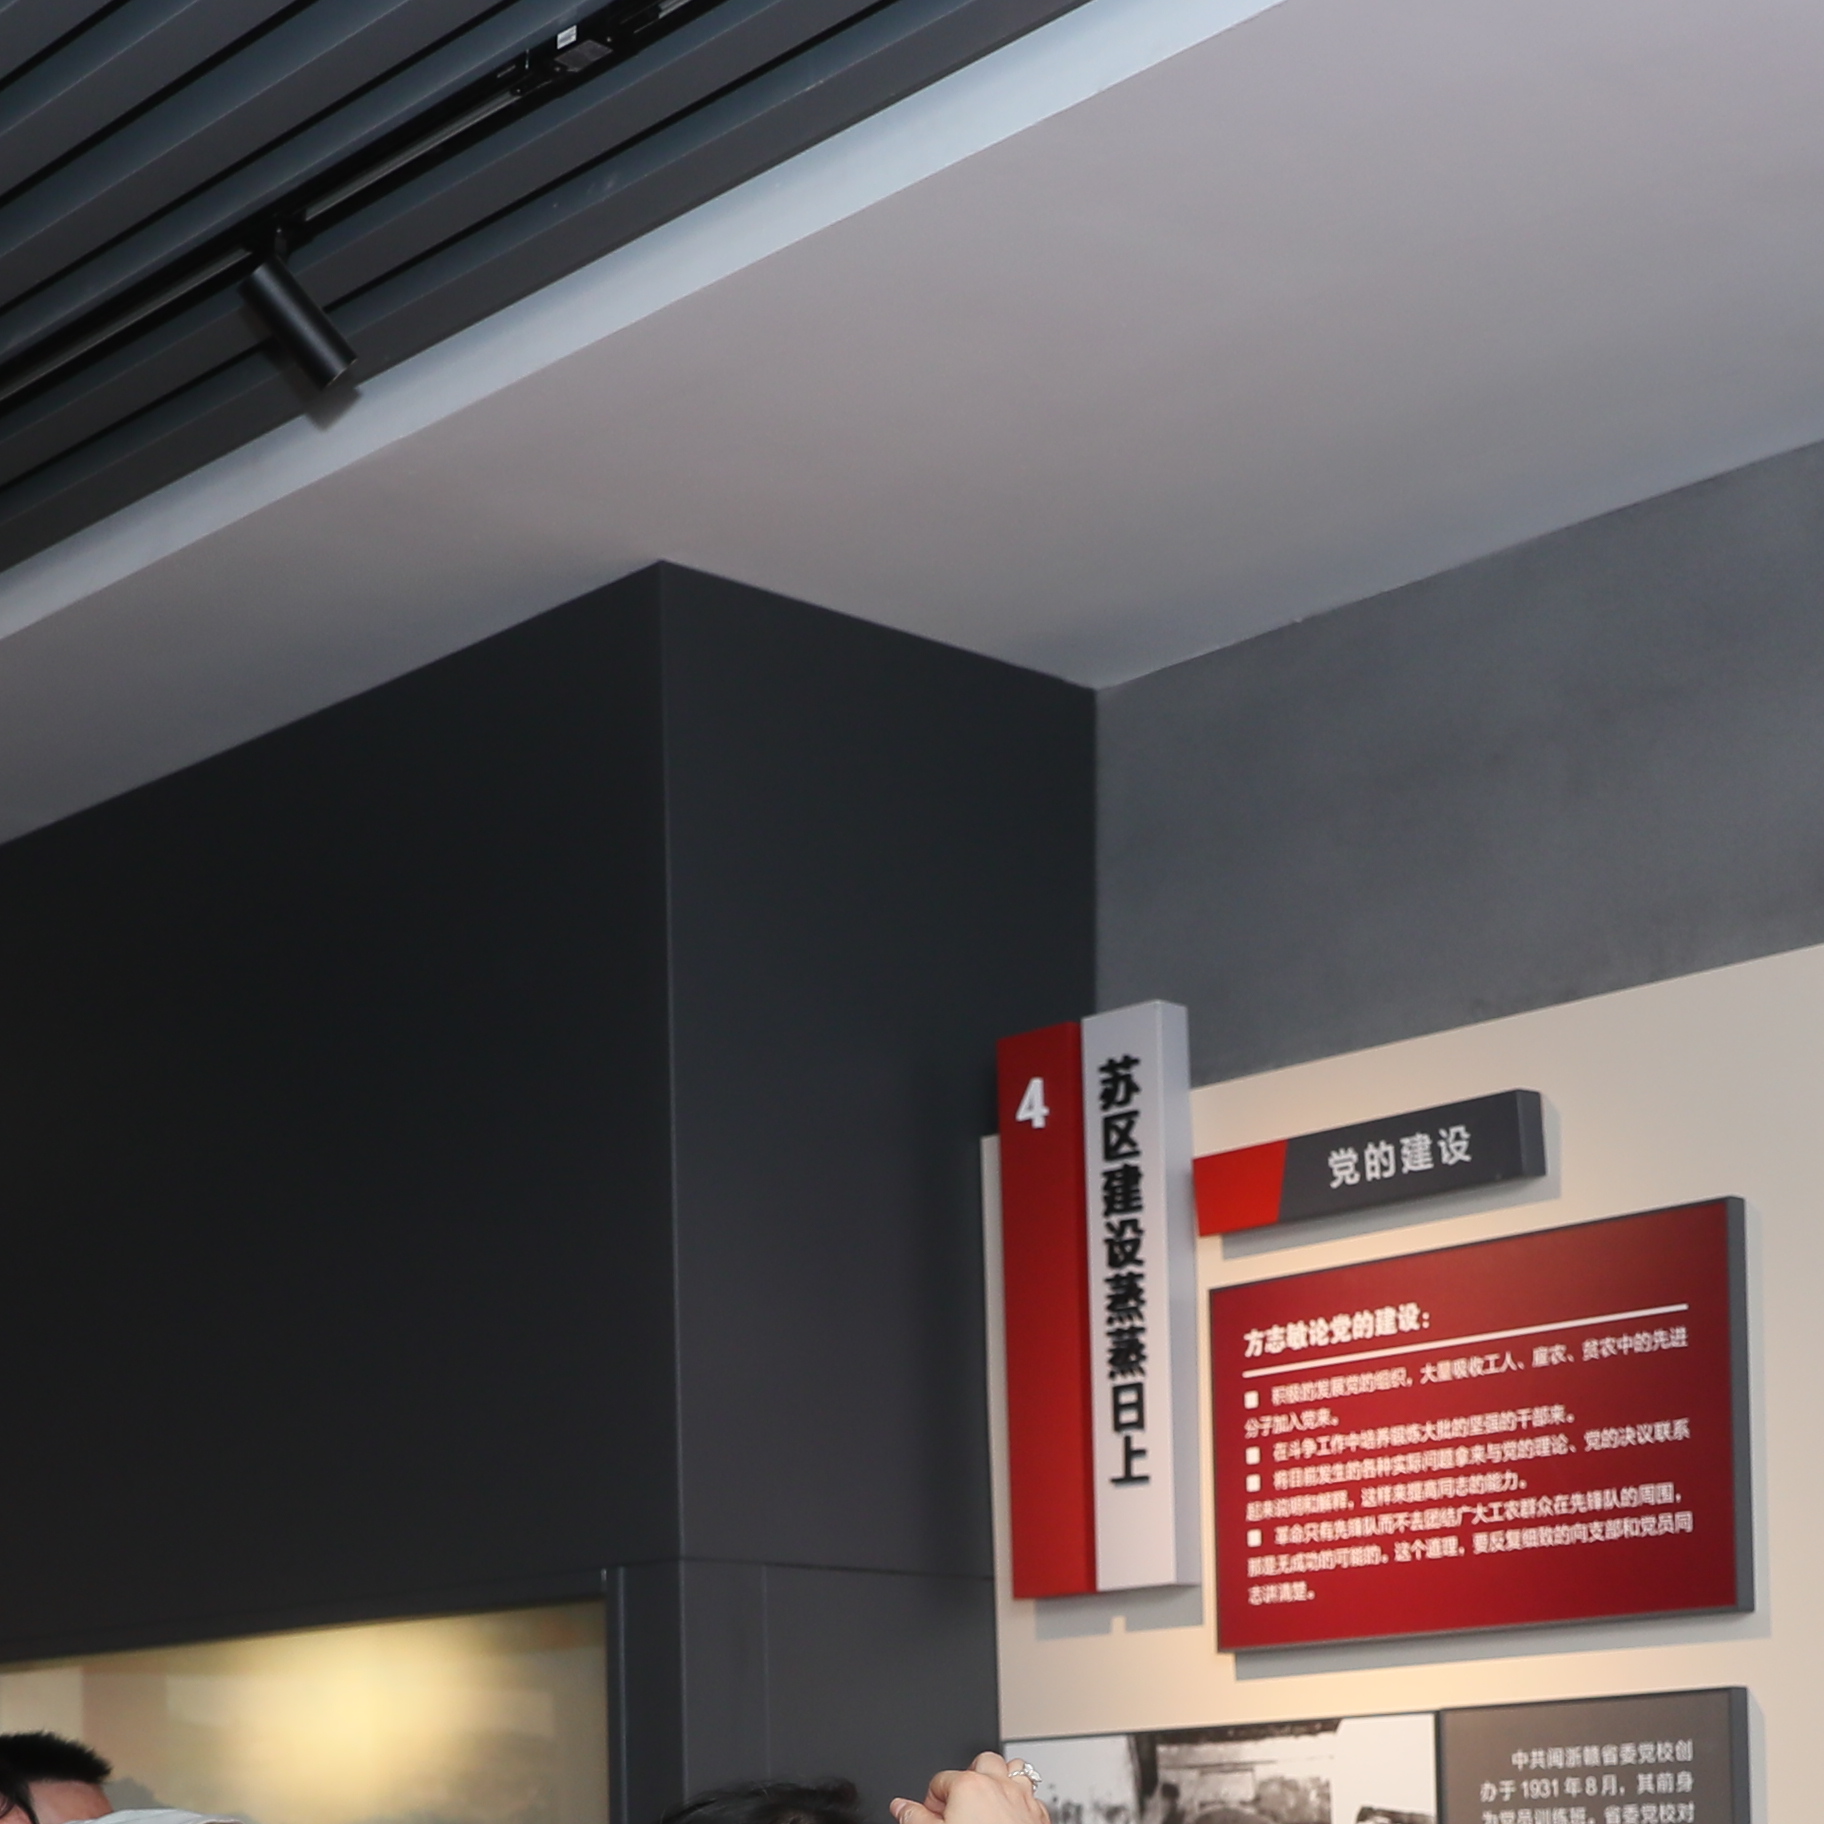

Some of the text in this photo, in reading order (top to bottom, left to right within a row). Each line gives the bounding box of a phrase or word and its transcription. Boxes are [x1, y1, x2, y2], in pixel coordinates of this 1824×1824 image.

[1015, 1077, 1049, 1128] 4
[1328, 1126, 1472, 1189] 党的建设
[1098, 1056, 1149, 1484] 苏区建设蒸蒸日上
